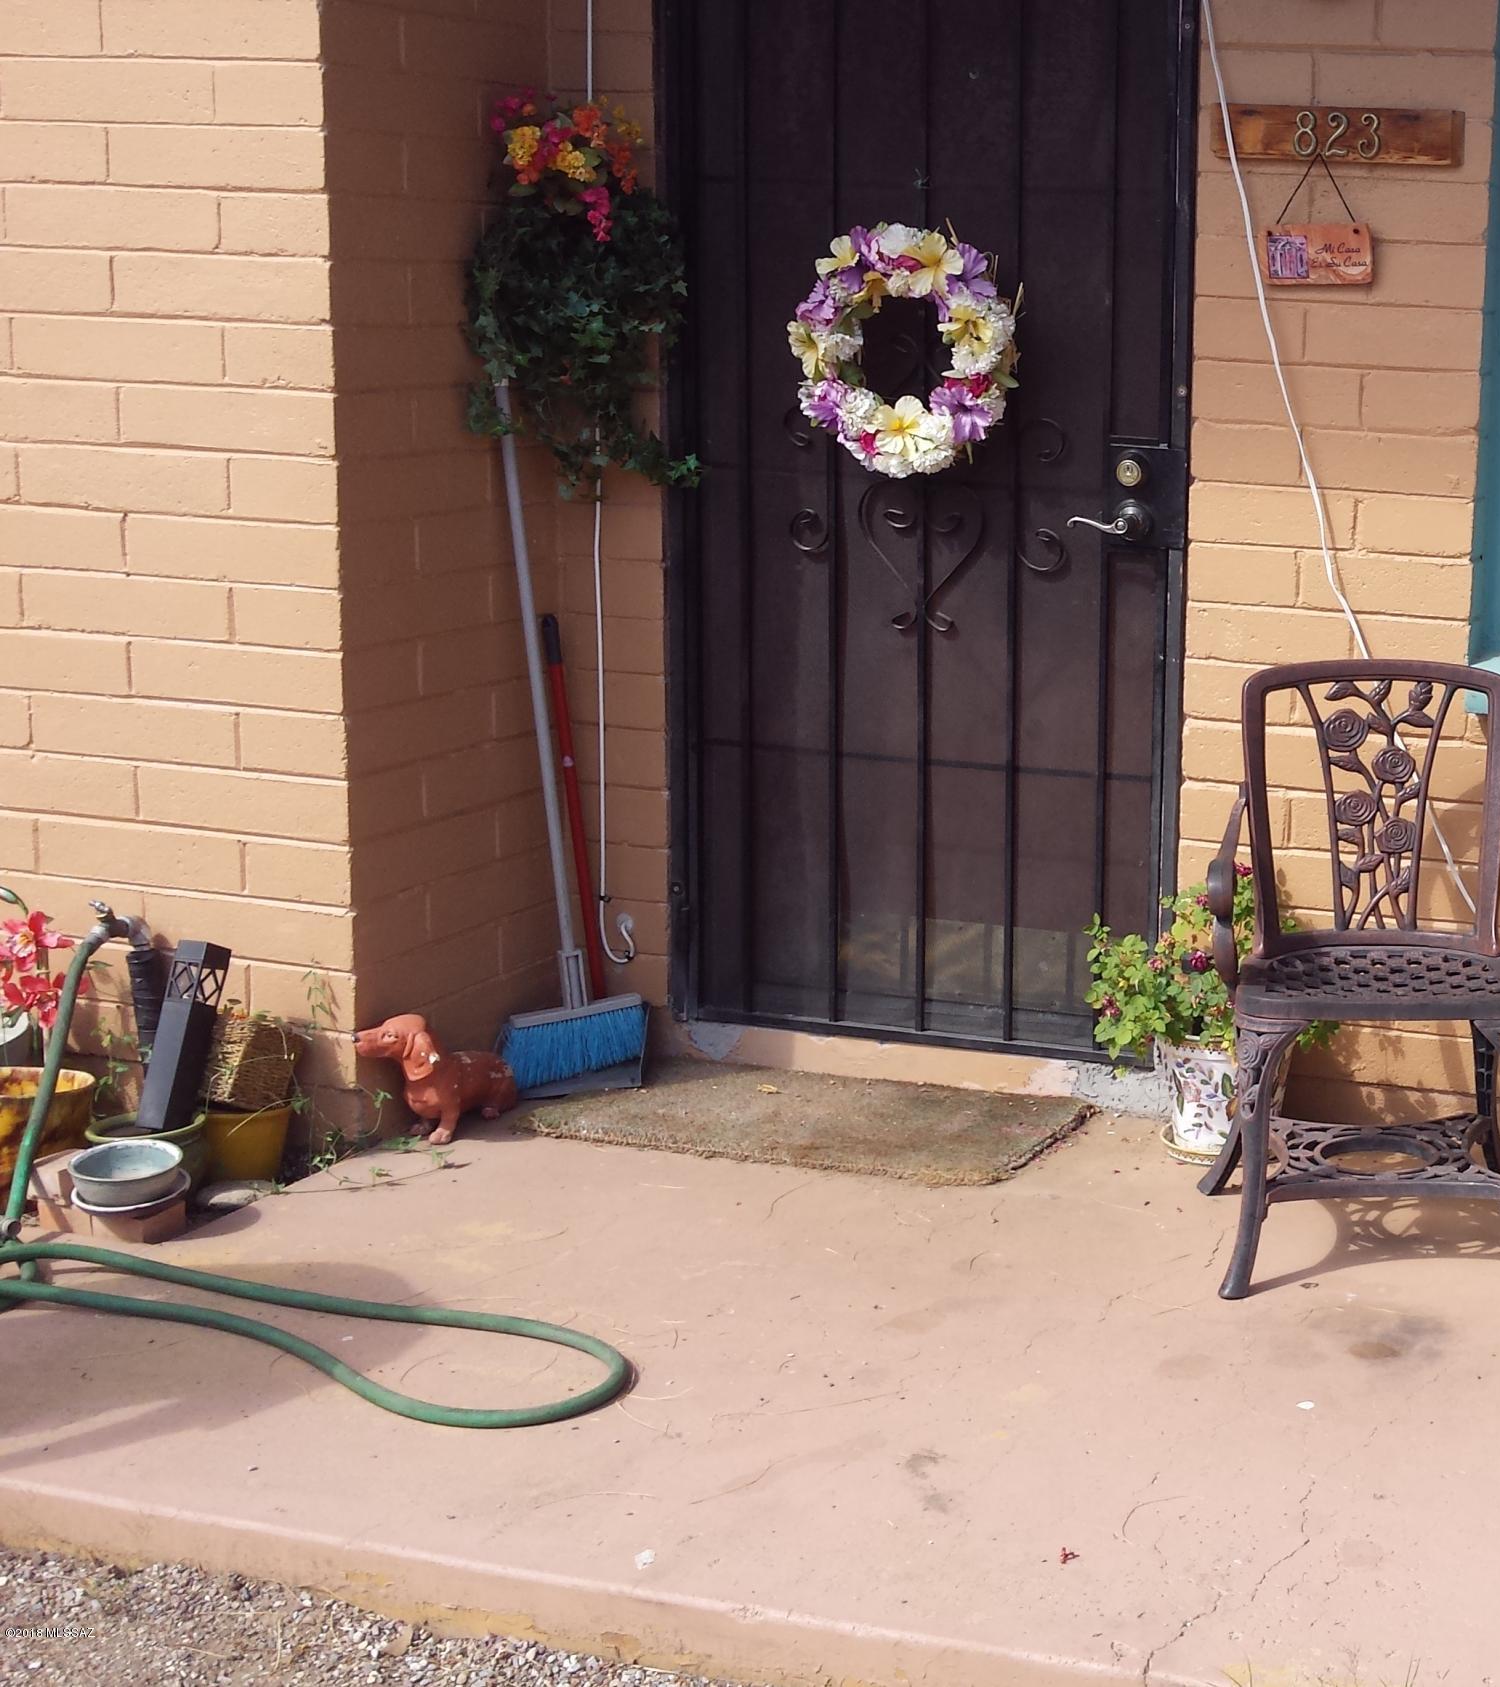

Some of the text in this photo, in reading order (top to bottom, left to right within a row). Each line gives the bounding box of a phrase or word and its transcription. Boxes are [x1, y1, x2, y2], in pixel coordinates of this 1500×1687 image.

[1293, 111, 1382, 159] 823
[1315, 242, 1361, 254] Mi Casa
[1325, 257, 1342, 268] Su
[1343, 256, 1368, 267] Casa
